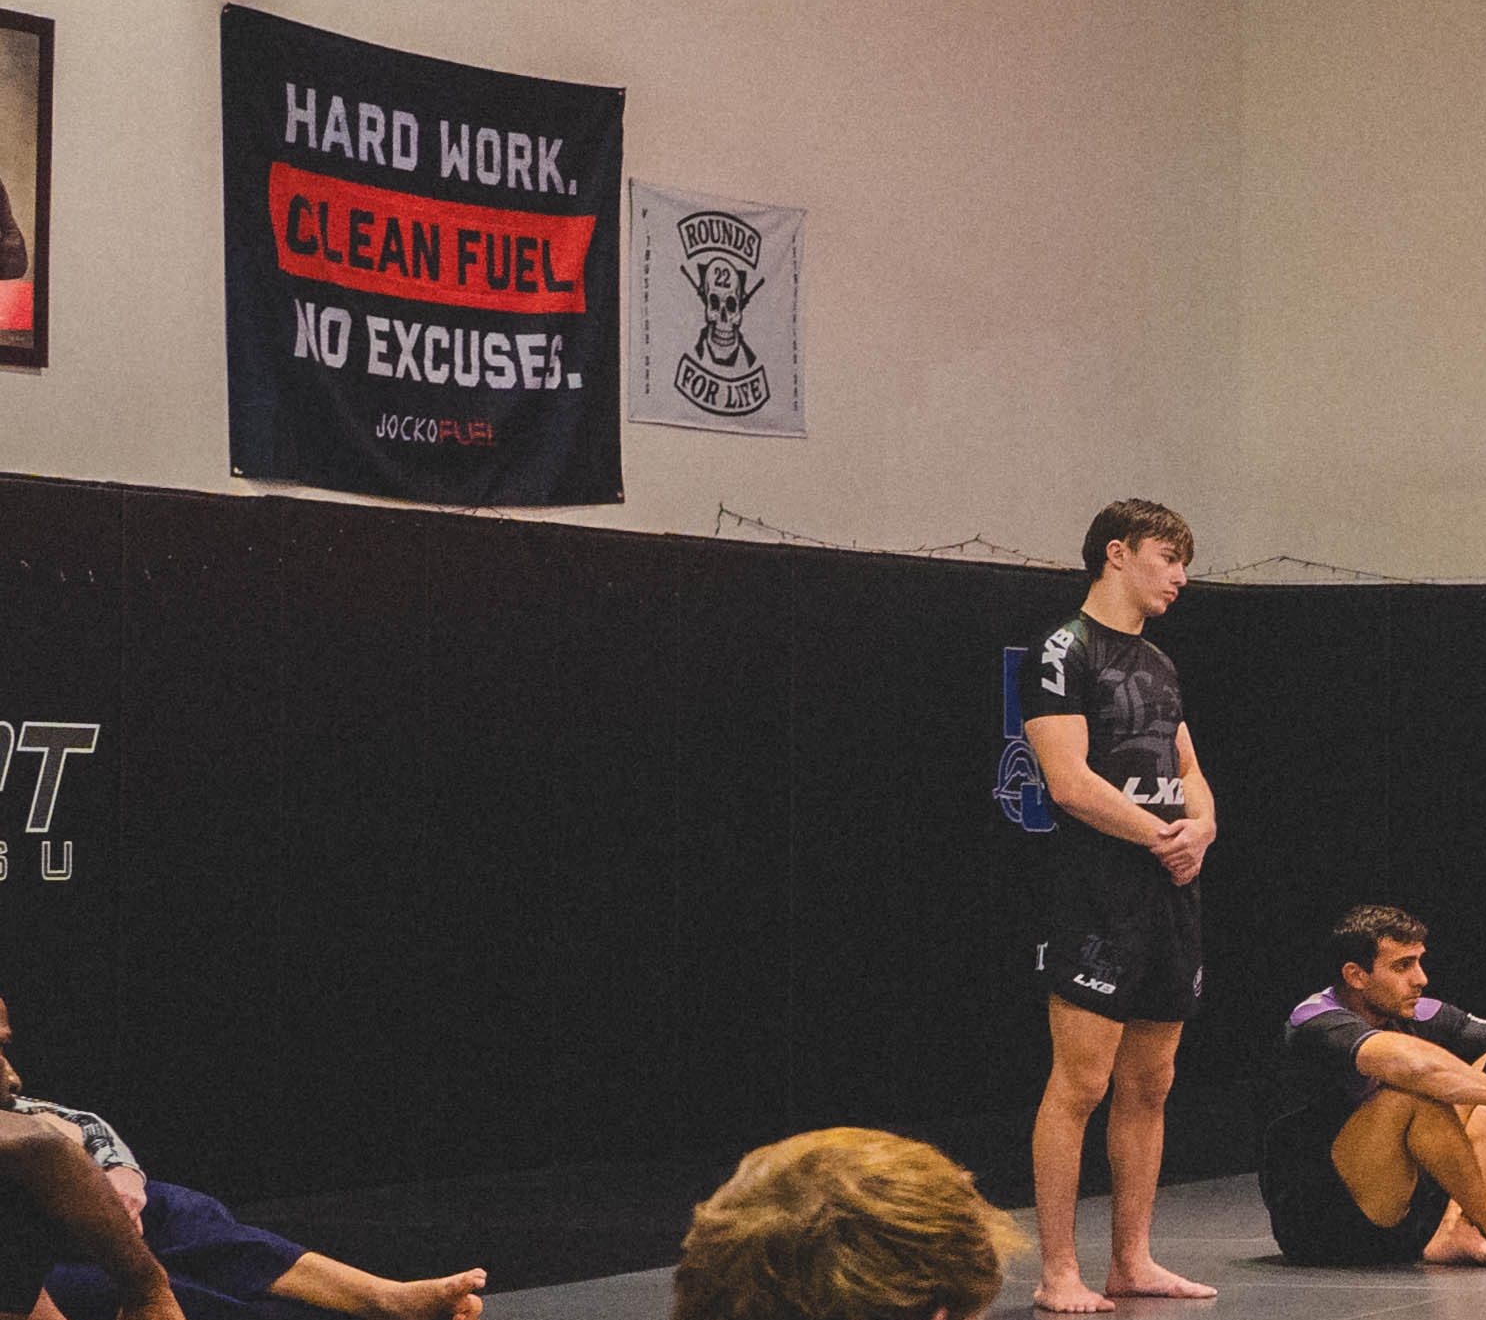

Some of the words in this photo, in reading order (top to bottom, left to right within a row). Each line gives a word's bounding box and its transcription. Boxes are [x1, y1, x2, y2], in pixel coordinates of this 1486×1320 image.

[284, 81, 419, 173] HARD
[439, 119, 578, 196] WORK.
[285, 193, 441, 283] CLEAN
[456, 228, 575, 294] FUEL
[684, 219, 757, 258] ROUNDS
[714, 267, 731, 289] 22
[293, 298, 353, 369] NO
[365, 314, 584, 390] EXCUSES.
[682, 364, 720, 406] FOR
[724, 377, 762, 410] LIFE
[0, 721, 101, 833] T
[1073, 973, 1117, 995] LXB
